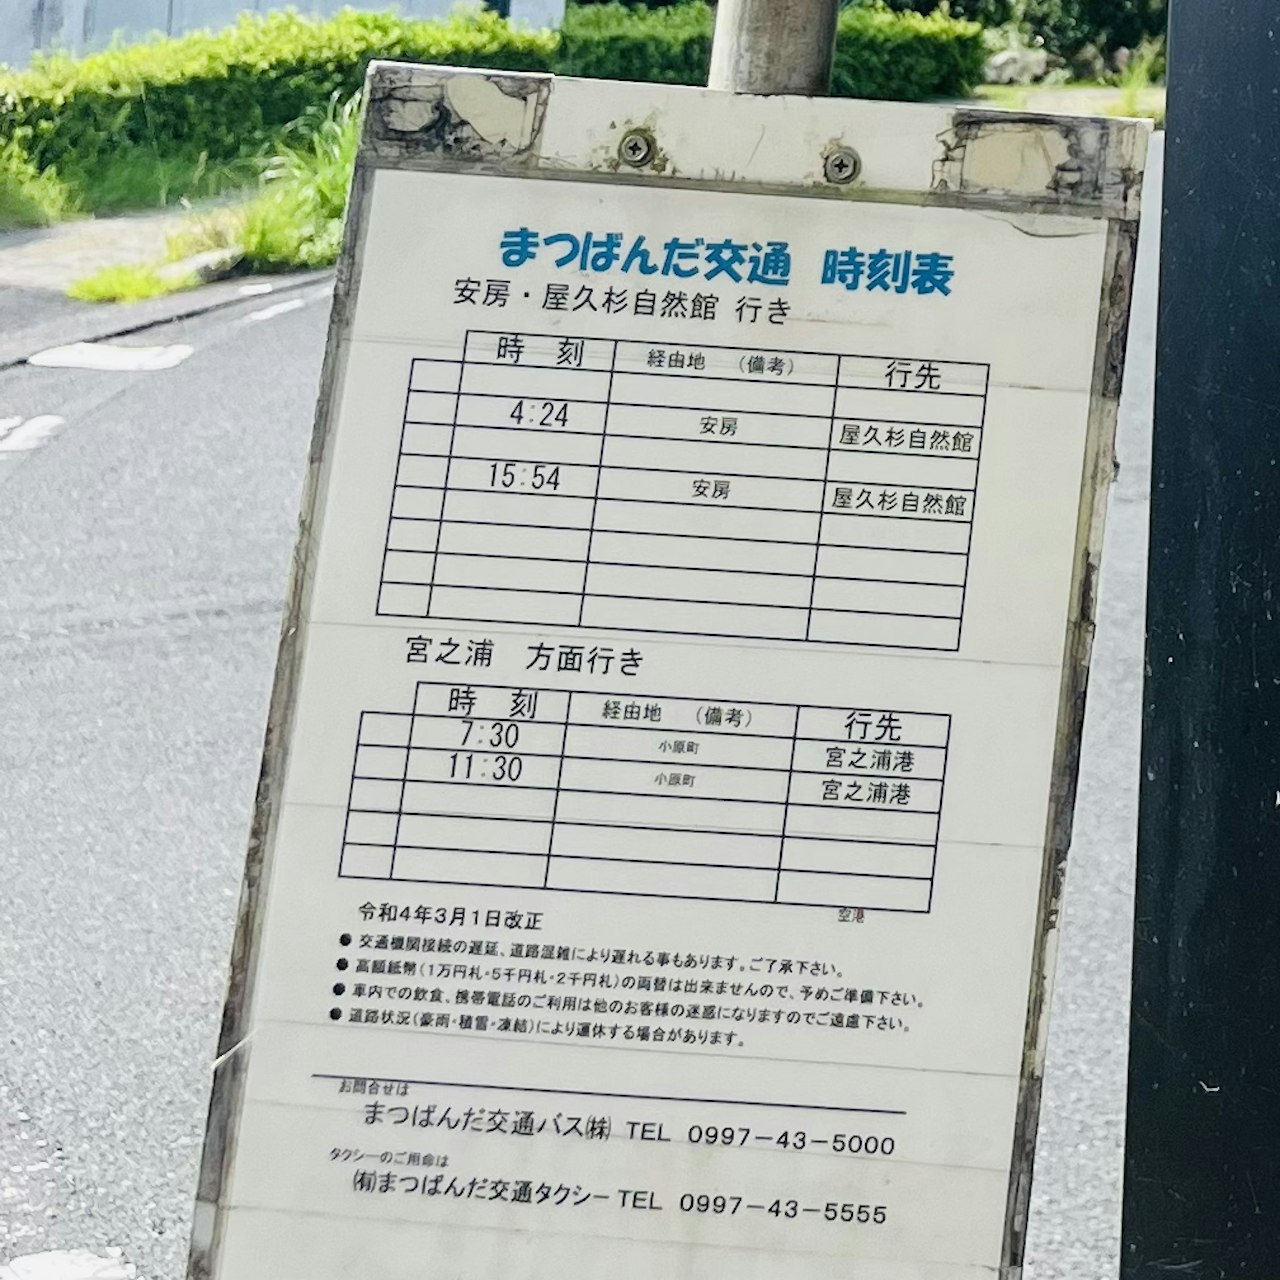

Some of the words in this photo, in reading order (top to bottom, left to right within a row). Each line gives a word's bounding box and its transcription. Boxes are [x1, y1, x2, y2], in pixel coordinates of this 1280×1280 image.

[499, 227, 792, 287] まつばんだ交通
[821, 246, 955, 297] 時刻表
[453, 277, 719, 322] 安房・屋久杉自然館
[735, 295, 792, 325] 行き
[647, 348, 706, 371] 経由地
[885, 359, 942, 392] 行先
[510, 400, 569, 428] 4:24
[700, 416, 738, 436] 安房
[839, 425, 975, 454] 屋久杉自然館
[489, 461, 561, 491] 15:54
[692, 479, 731, 500] 安房
[832, 487, 968, 517] 屋久杉自然館
[405, 635, 495, 668] 宮之浦
[526, 642, 644, 676] 方面行き
[602, 700, 662, 724] 経由地
[844, 710, 902, 742] 行先
[461, 720, 520, 749] 7:30
[825, 746, 915, 773] 宮之浦港
[449, 753, 523, 782] 11:30
[821, 779, 911, 805] 宮之浦港
[358, 901, 544, 931] 令和4年3月1日改正
[838, 907, 866, 923] 空港
[339, 1079, 410, 1096] お問合せは
[626, 1121, 671, 1142] TEL
[329, 1147, 449, 1168] タクシーのご用命は
[618, 1189, 663, 1210] TEL
